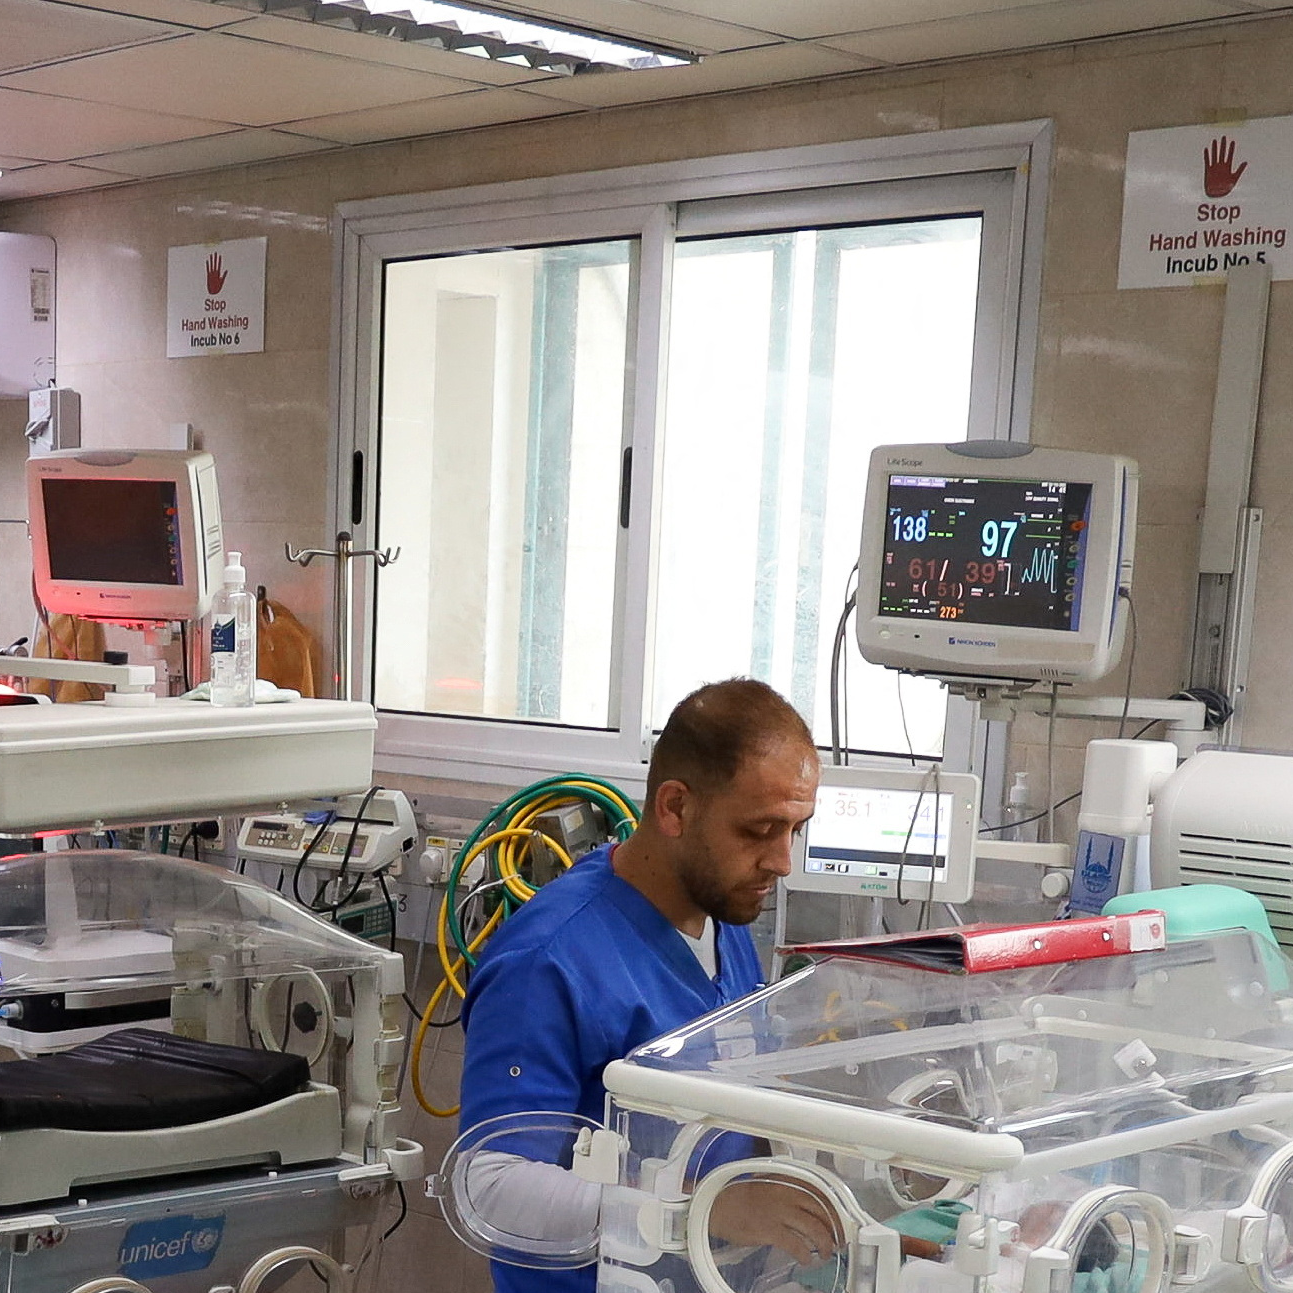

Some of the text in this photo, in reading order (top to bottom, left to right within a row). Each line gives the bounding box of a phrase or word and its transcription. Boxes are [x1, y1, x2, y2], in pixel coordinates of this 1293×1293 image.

[1197, 203, 1241, 224] Stop
[1149, 226, 1286, 251] Hand Washing
[1166, 253, 1218, 274] Incub
[204, 299, 226, 313] Stop
[182, 315, 249, 331] Hand Washing
[190, 332, 240, 347] Incub No 6
[893, 515, 927, 542] 138
[981, 520, 1018, 558] 97
[939, 606, 957, 619] 273
[835, 799, 872, 817] 35.1
[398, 893, 407, 912] 3
[121, 1231, 192, 1264] unicef
